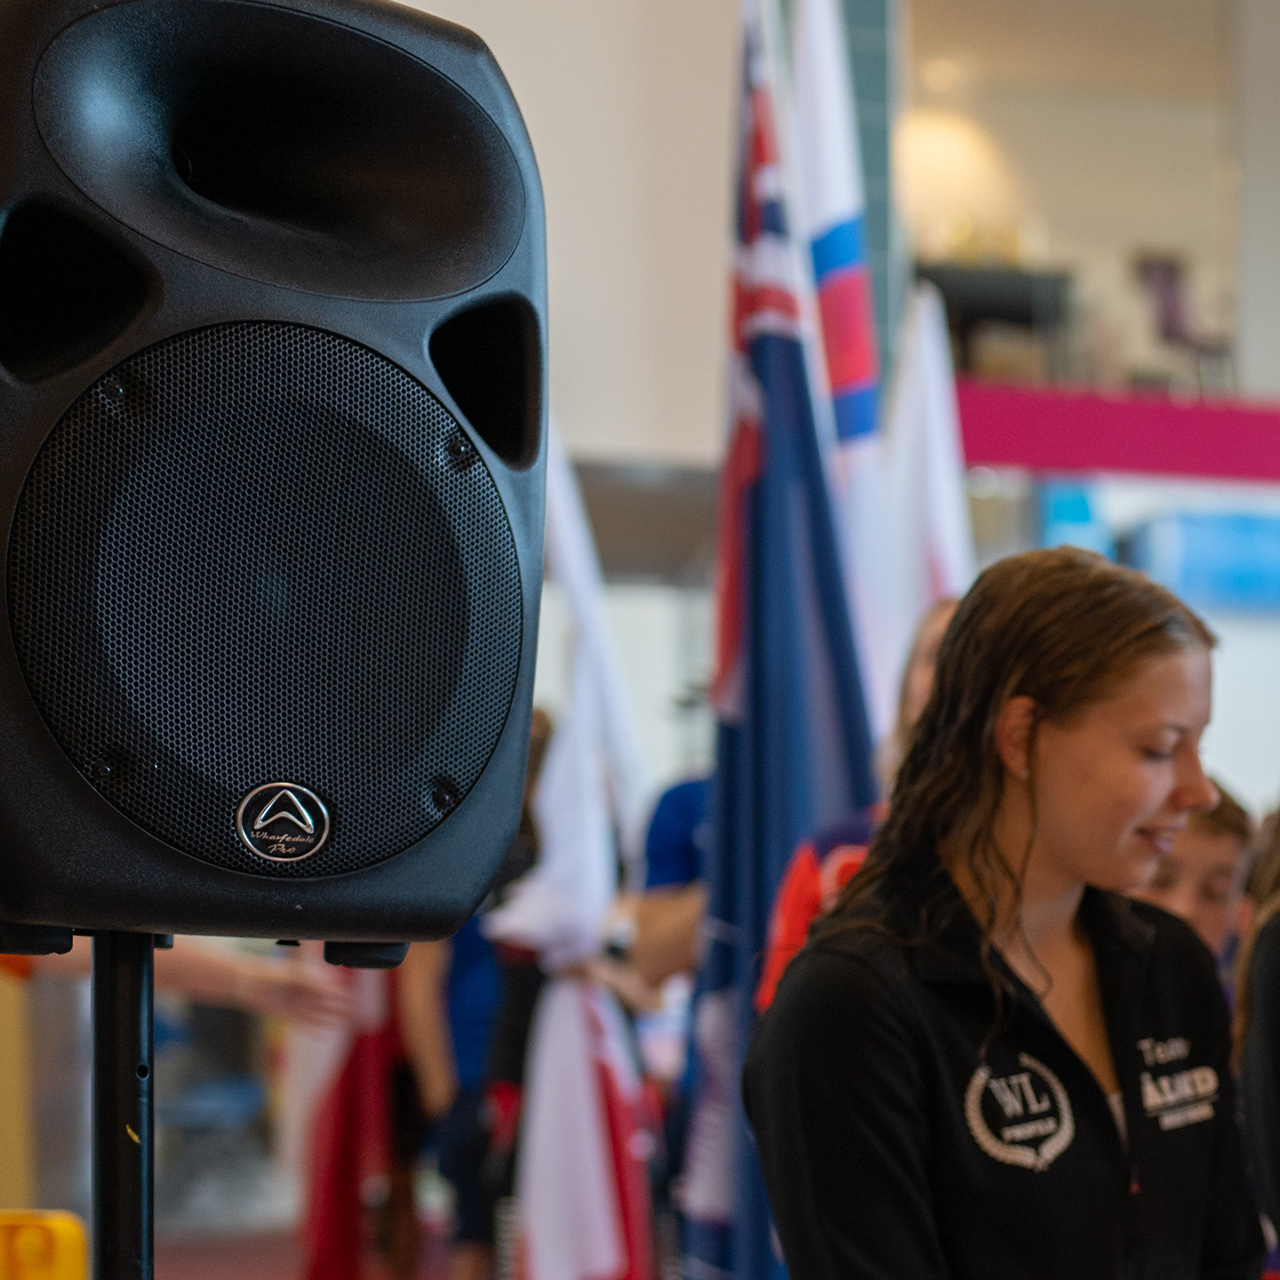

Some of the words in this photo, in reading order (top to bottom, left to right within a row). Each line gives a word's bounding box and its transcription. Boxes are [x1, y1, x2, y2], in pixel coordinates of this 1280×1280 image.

[250, 830, 315, 843] Wharfedale
[268, 843, 296, 854] Pro
[988, 1072, 1051, 1118] WL
